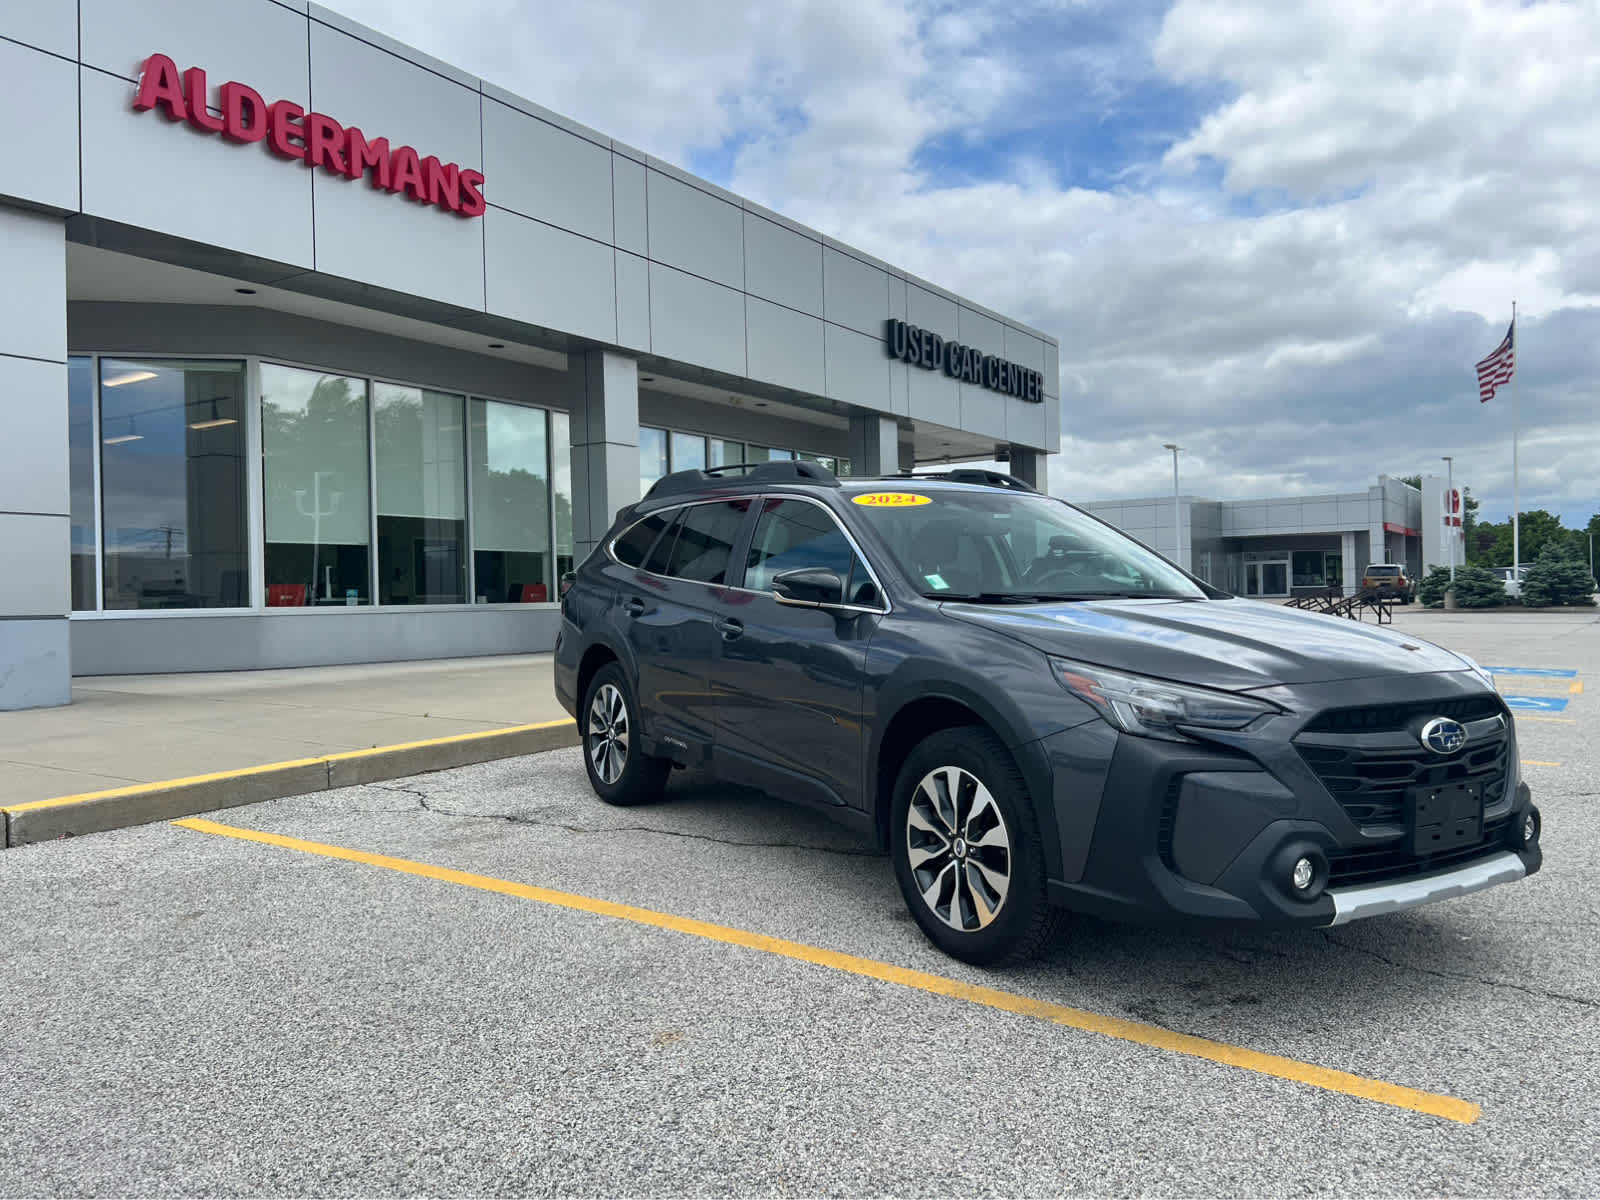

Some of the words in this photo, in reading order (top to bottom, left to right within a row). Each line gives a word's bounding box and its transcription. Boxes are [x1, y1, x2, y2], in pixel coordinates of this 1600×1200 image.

[133, 53, 486, 217] ALDERMANS
[888, 319, 944, 370] USED
[946, 341, 984, 384] CAR
[985, 355, 1044, 402] CENTER
[867, 495, 916, 505] 2024
